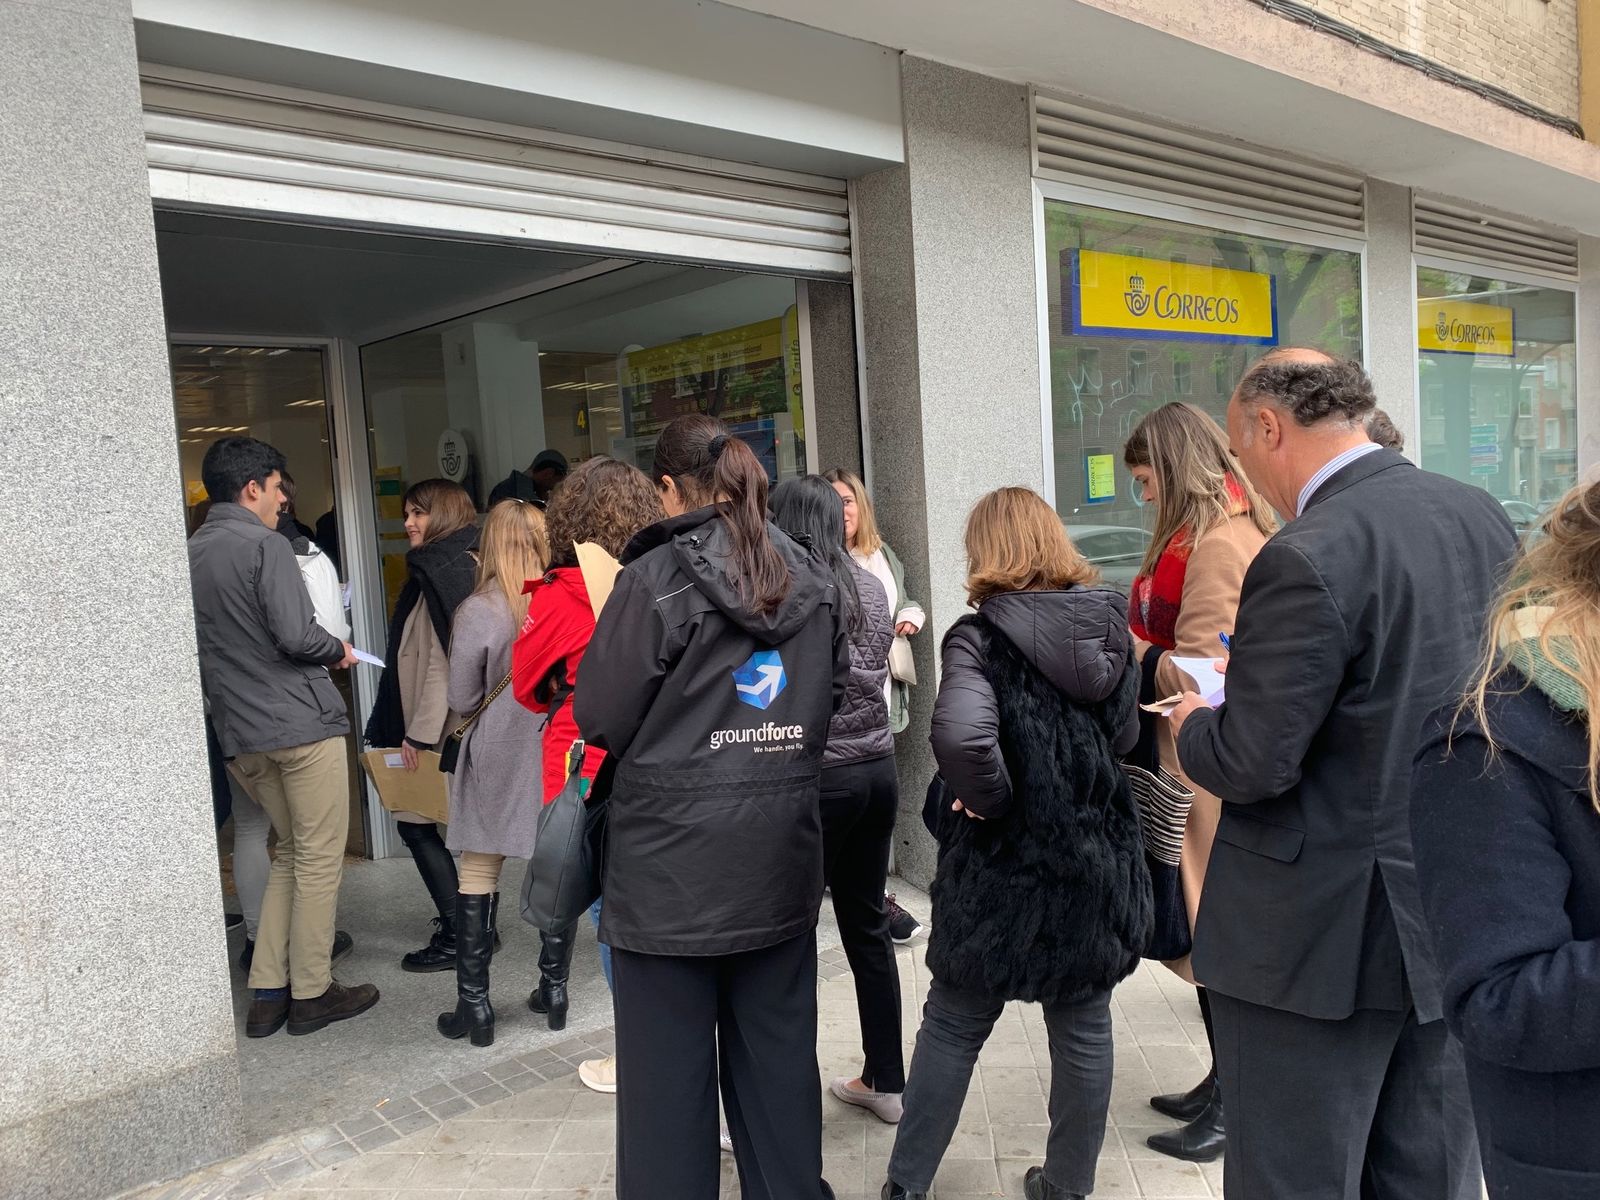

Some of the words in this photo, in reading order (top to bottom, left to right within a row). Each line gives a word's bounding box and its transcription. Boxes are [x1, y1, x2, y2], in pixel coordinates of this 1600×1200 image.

[1154, 285, 1239, 324] CORREOS
[1450, 318, 1496, 345] CORREOS
[576, 409, 586, 429] 4
[709, 721, 803, 749] groundforce
